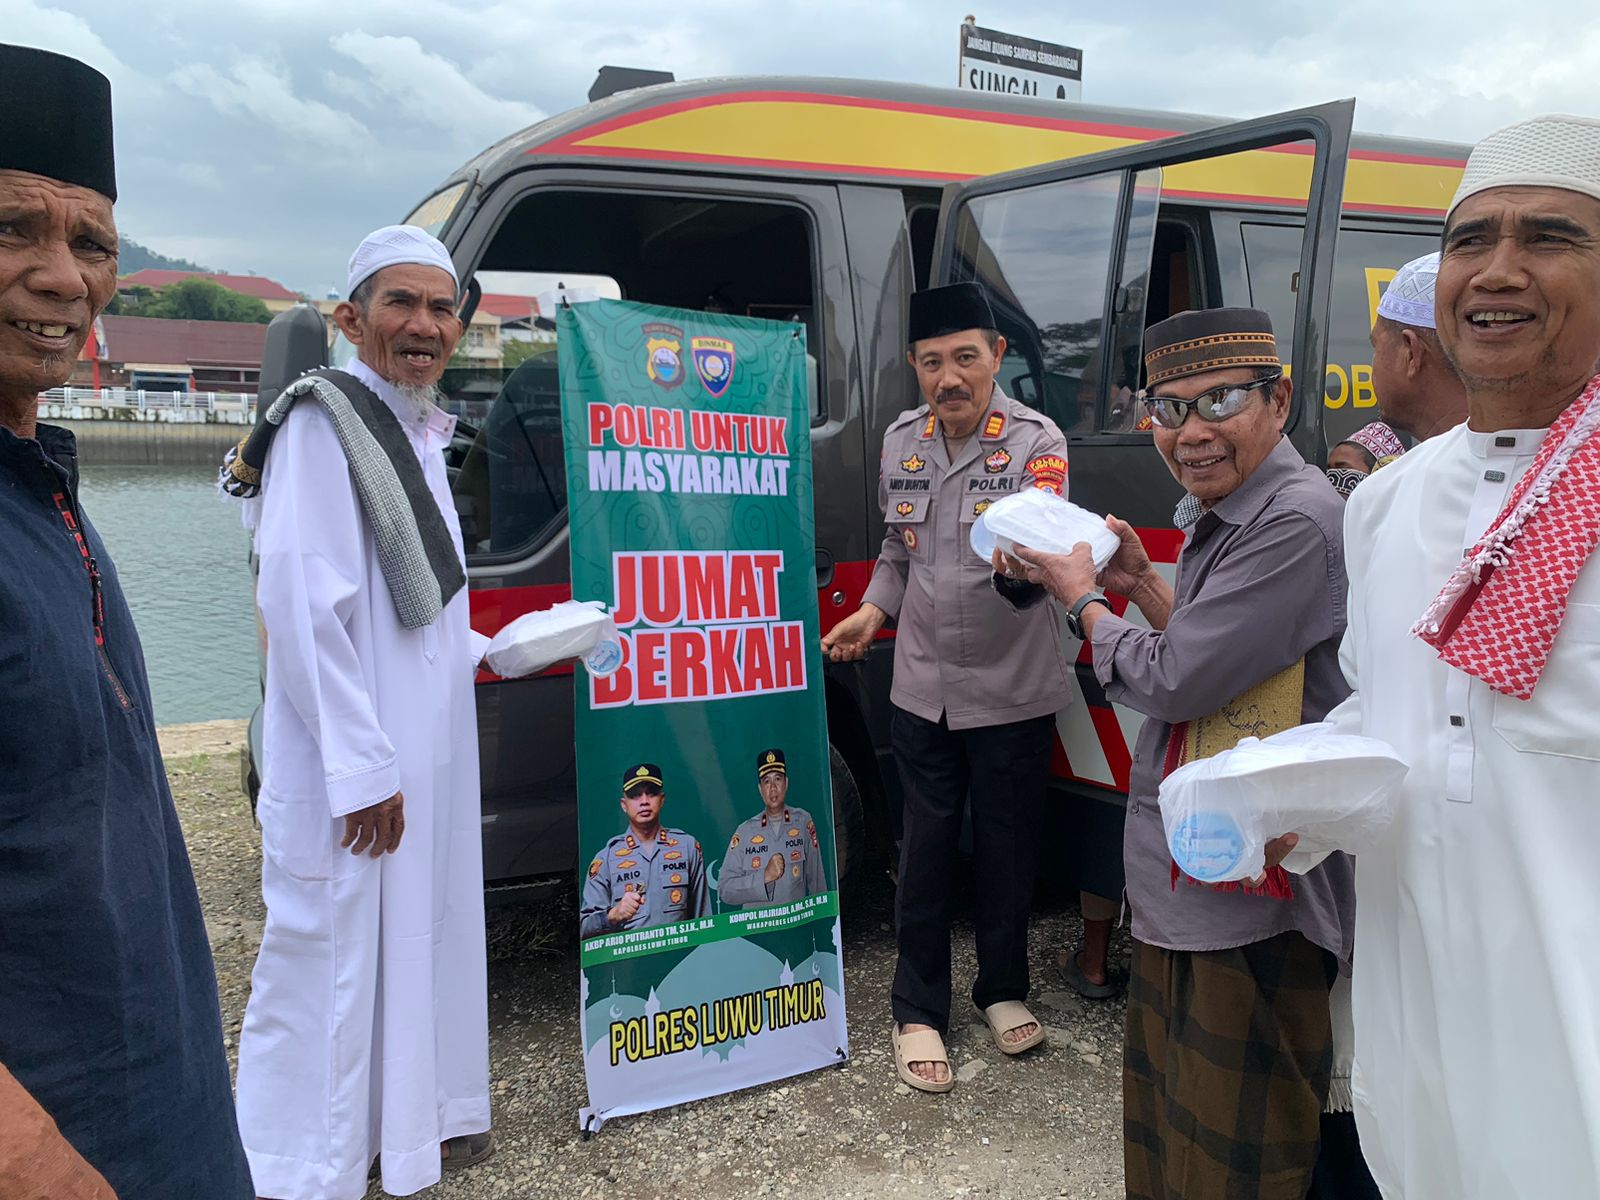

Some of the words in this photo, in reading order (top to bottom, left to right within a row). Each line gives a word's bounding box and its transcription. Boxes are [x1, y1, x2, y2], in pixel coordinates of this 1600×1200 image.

[588, 402, 685, 450] POLRI
[689, 410, 789, 457] UNTUK
[588, 450, 790, 496] MASYARAKAT
[968, 478, 1014, 491] POLRI
[608, 550, 784, 627] JUMAT
[590, 620, 807, 709] BERKAH
[745, 845, 769, 855] HAJRI
[785, 839, 804, 848] POLRI
[663, 862, 687, 871] POLRI
[616, 870, 641, 882] ARIO
[729, 911, 757, 924] KOMPOL
[584, 940, 604, 952] AKBP
[605, 936, 624, 947] ARIO
[625, 928, 664, 943] PUTRANTO
[613, 943, 647, 956] KAPOLRES
[609, 1005, 698, 1066] POLRES
[701, 990, 762, 1046] LUWU
[764, 978, 826, 1031] TIMUR
